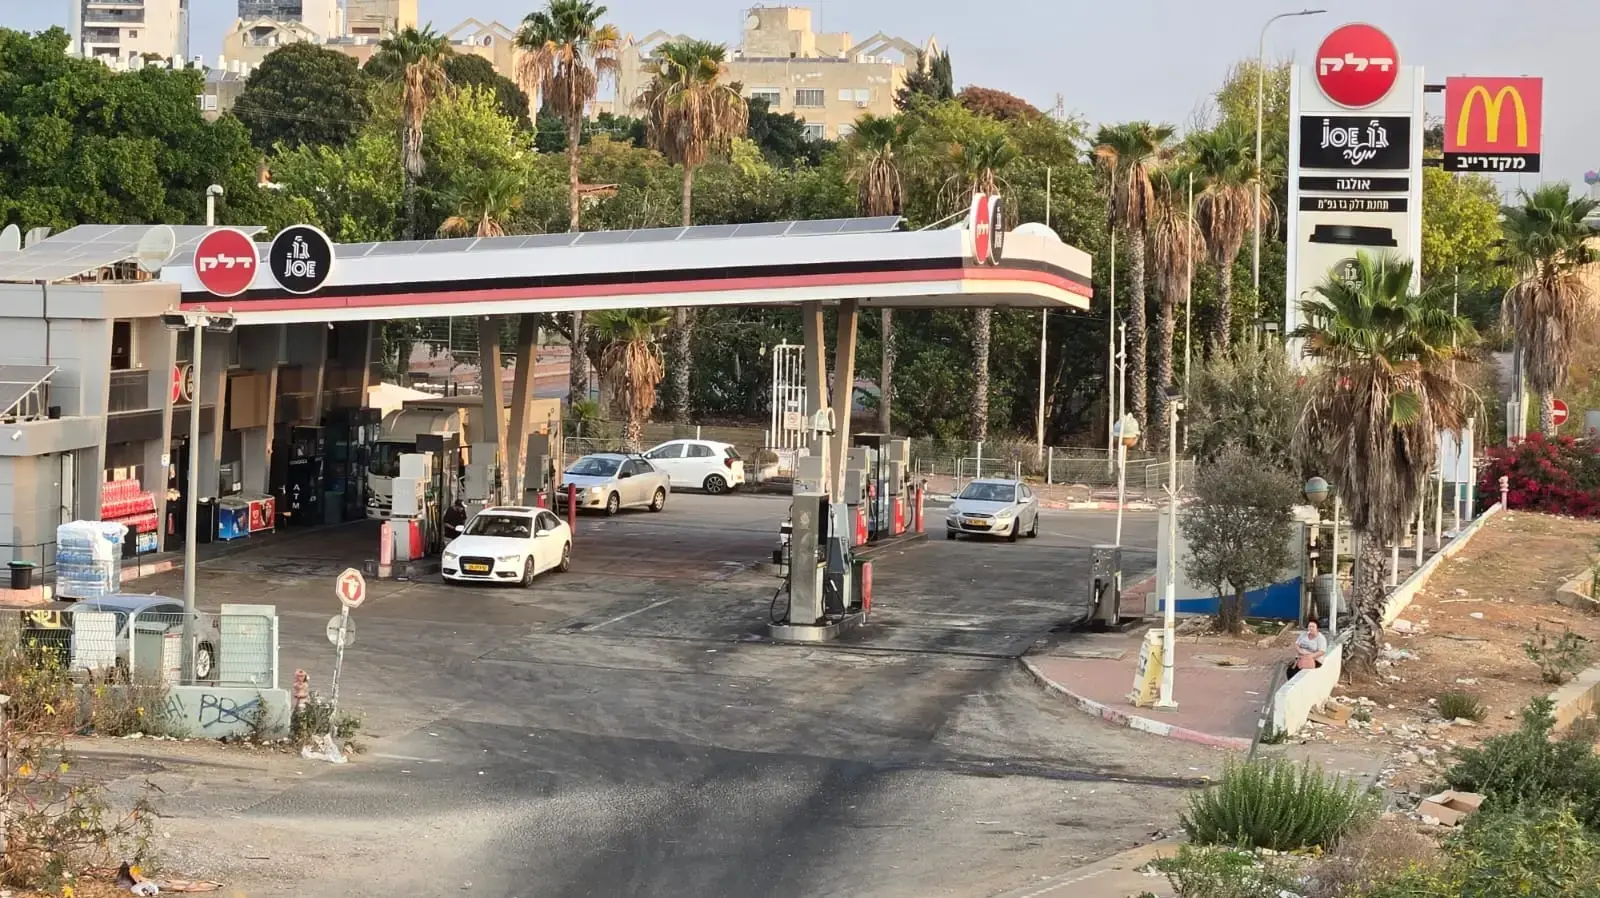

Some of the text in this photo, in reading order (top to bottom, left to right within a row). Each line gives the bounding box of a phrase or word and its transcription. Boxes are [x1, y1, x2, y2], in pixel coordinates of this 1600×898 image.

[1320, 52, 1393, 76] דלק
[1457, 156, 1526, 171] מקדרייב
[1336, 178, 1371, 190] אולגה
[1348, 198, 1365, 211] דלק
[1366, 199, 1389, 210] תחנת
[199, 253, 253, 272] דלק
[292, 483, 301, 510] ATM
